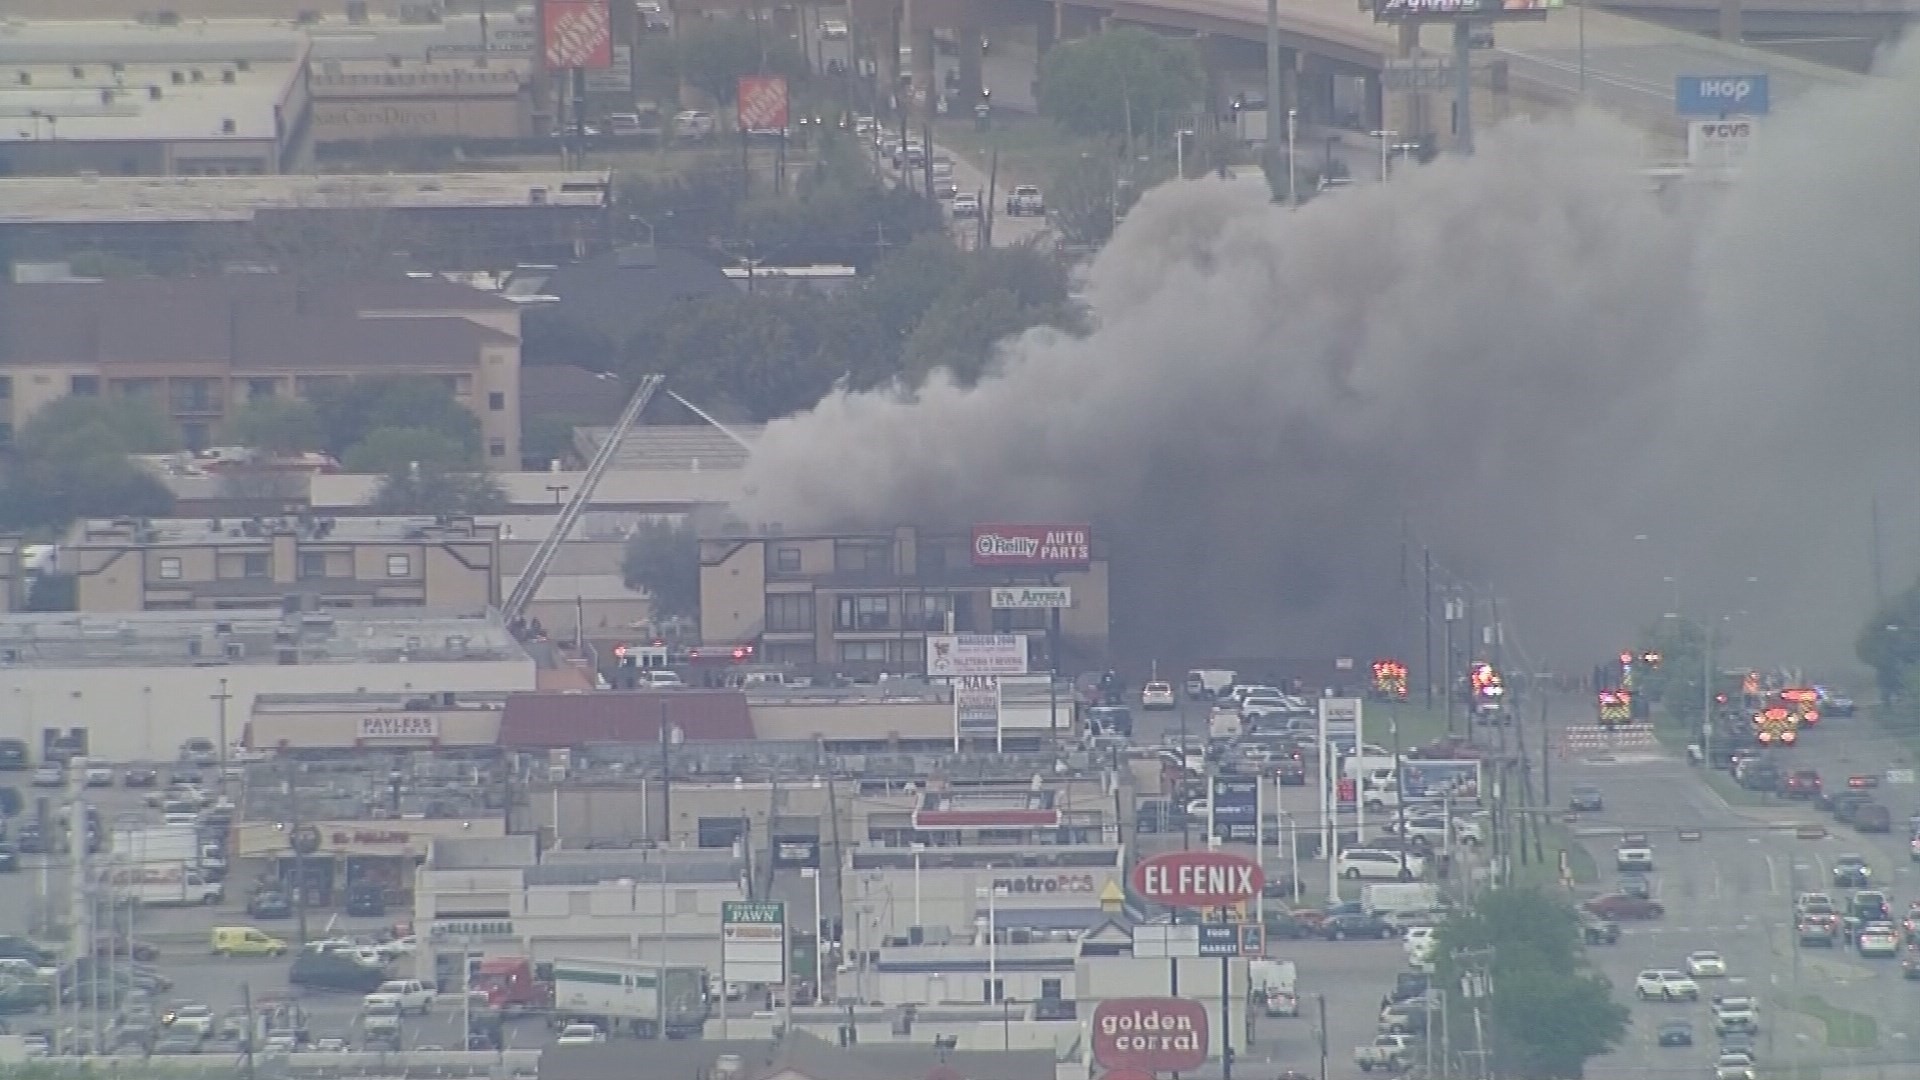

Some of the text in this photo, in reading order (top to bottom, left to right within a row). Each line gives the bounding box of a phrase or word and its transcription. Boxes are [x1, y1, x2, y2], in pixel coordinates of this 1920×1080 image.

[1718, 124, 1750, 138] CVS
[1046, 531, 1084, 544] AUTO
[976, 534, 1039, 557] O'Reilly
[1041, 546, 1088, 560] PARTS
[963, 675, 998, 690] NAILS
[363, 718, 432, 728] PAYLESS
[1145, 865, 1253, 895] EL FENIX
[732, 910, 775, 921] PAWN
[1102, 1010, 1191, 1035] golden
[1115, 1031, 1199, 1051] corral
